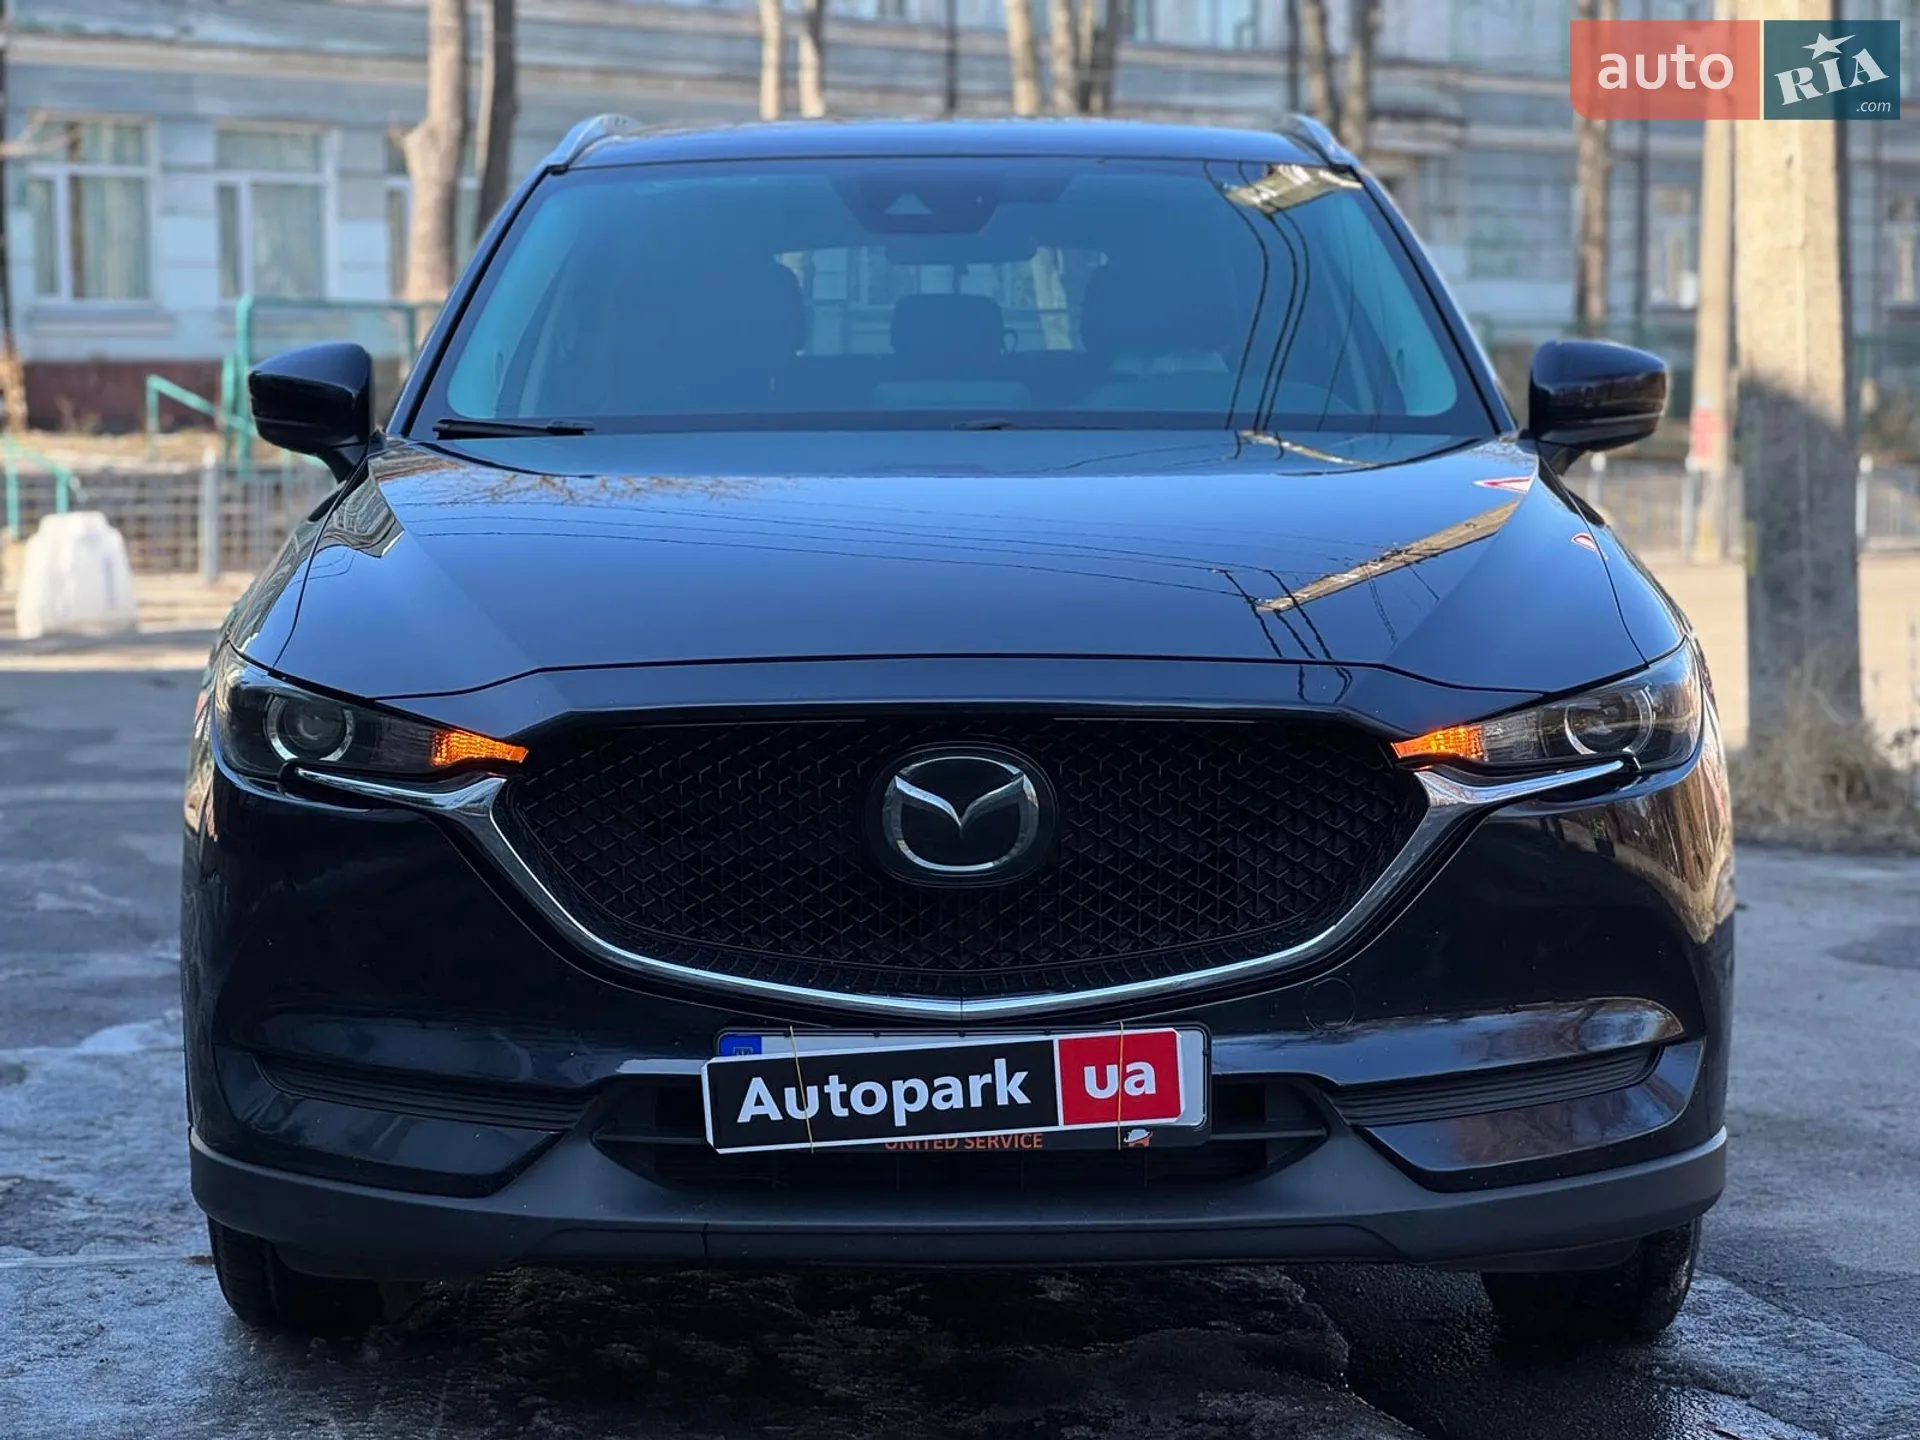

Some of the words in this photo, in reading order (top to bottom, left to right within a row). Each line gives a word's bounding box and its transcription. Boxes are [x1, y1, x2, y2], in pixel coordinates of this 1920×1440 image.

[737, 1058, 1031, 1126] Autopark
[1083, 1061, 1156, 1099] ua
[964, 1133, 1043, 1149] SERVICE
